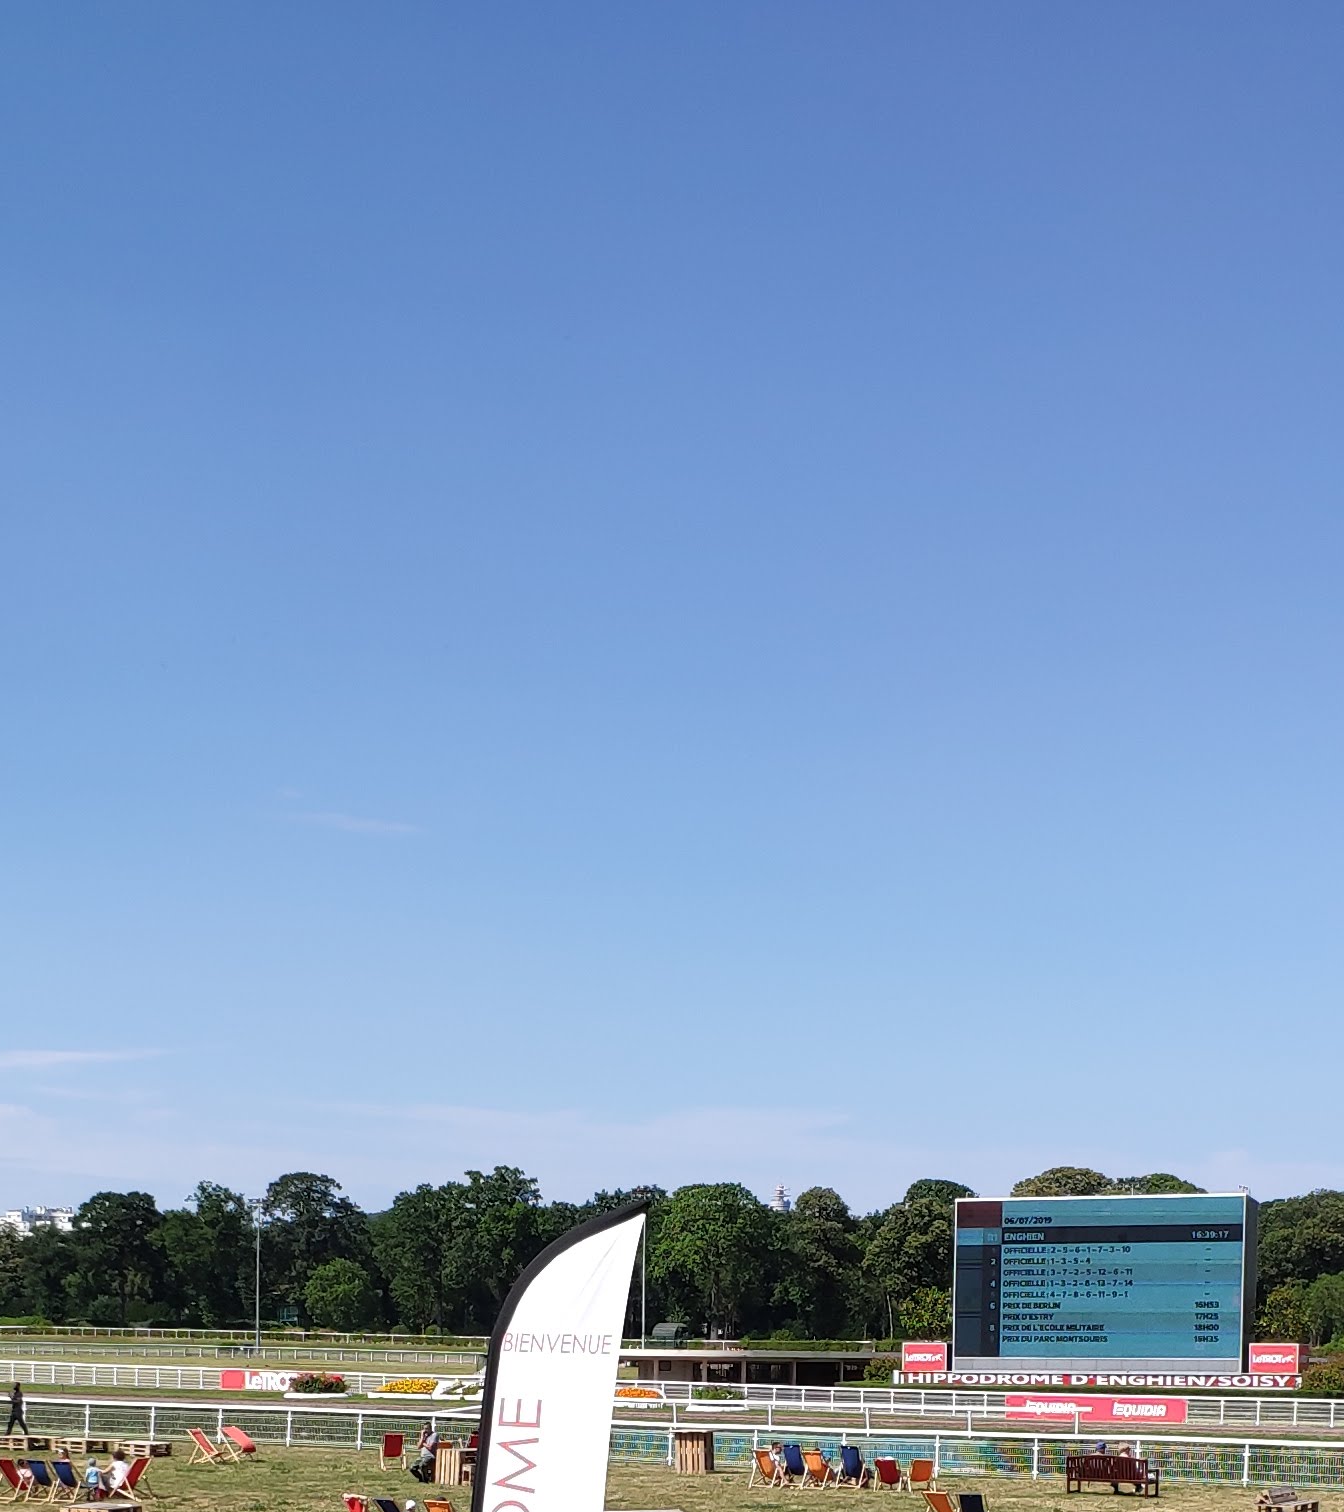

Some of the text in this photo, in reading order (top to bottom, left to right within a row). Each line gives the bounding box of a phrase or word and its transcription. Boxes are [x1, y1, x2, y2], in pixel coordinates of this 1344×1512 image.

[1003, 1232, 1045, 1241] ENGHIEN
[503, 1333, 613, 1355] BIENVENUE
[907, 1373, 1292, 1387] HIPPODROME D'ENGHIEN/SOISY
